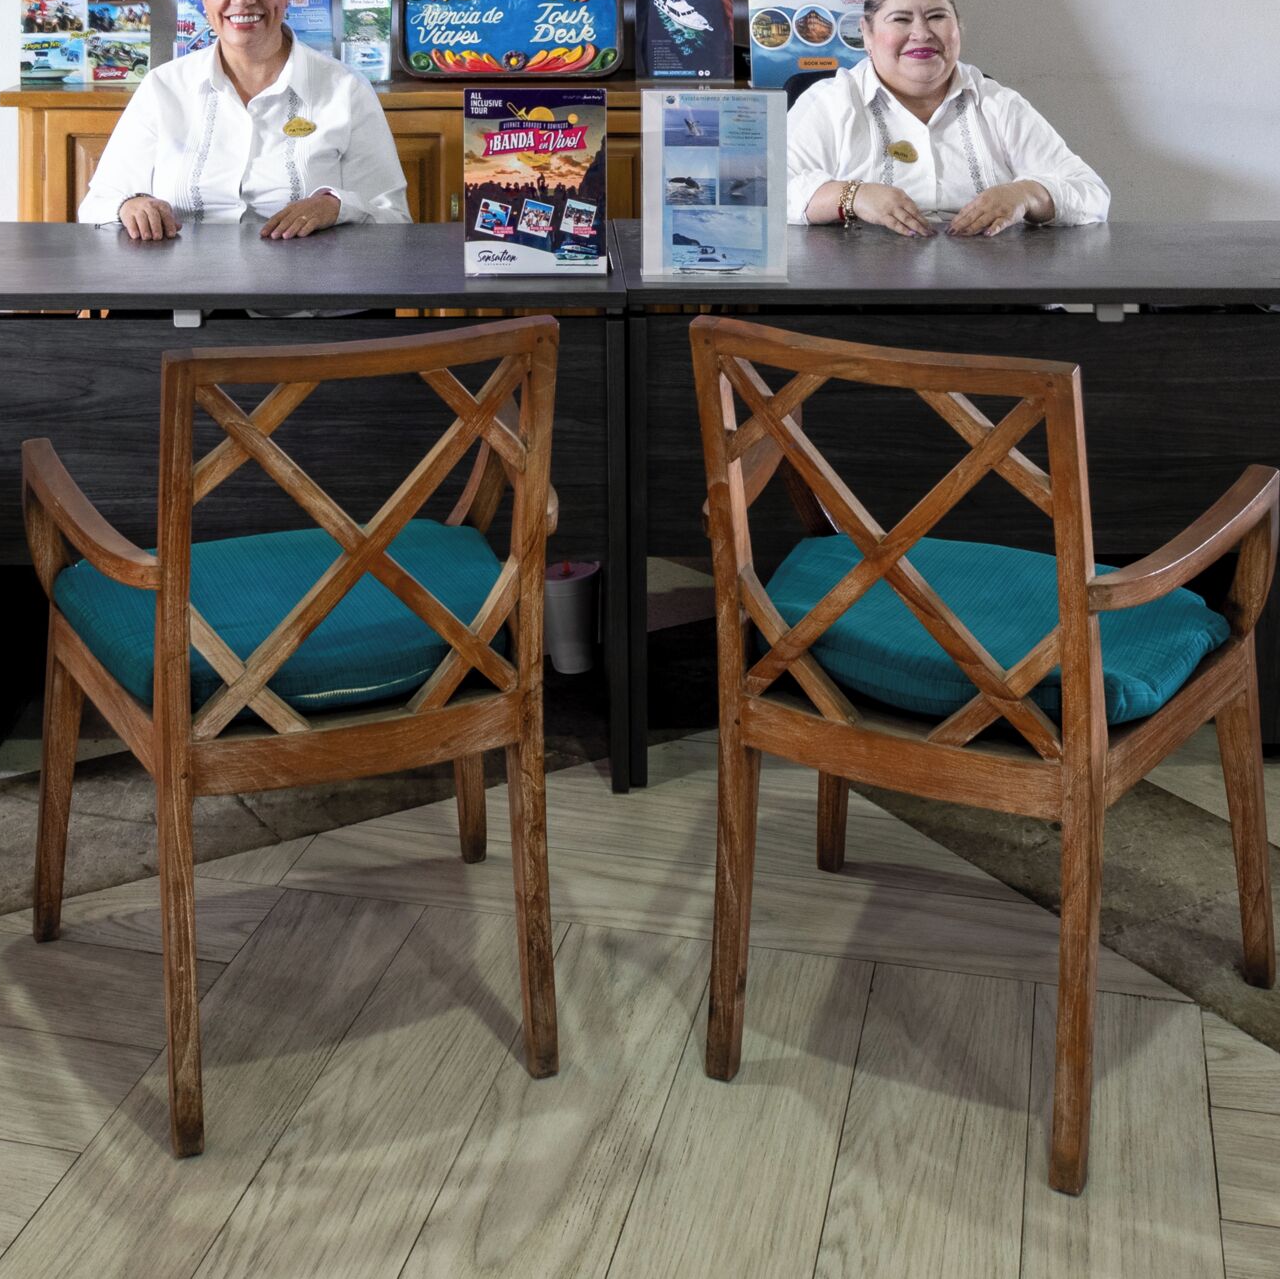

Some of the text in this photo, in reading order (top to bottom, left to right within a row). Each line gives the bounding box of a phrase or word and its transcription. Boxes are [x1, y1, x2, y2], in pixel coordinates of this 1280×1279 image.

[410, 5, 504, 32] Agencia de
[534, 3, 594, 25] Tour
[417, 25, 481, 47] Viajes
[530, 24, 596, 44] Desk
[470, 92, 482, 100] ALL
[470, 107, 488, 115] TOUR
[489, 130, 581, 154] ¡BANDA en Vivo!
[477, 250, 518, 263] Sensation
